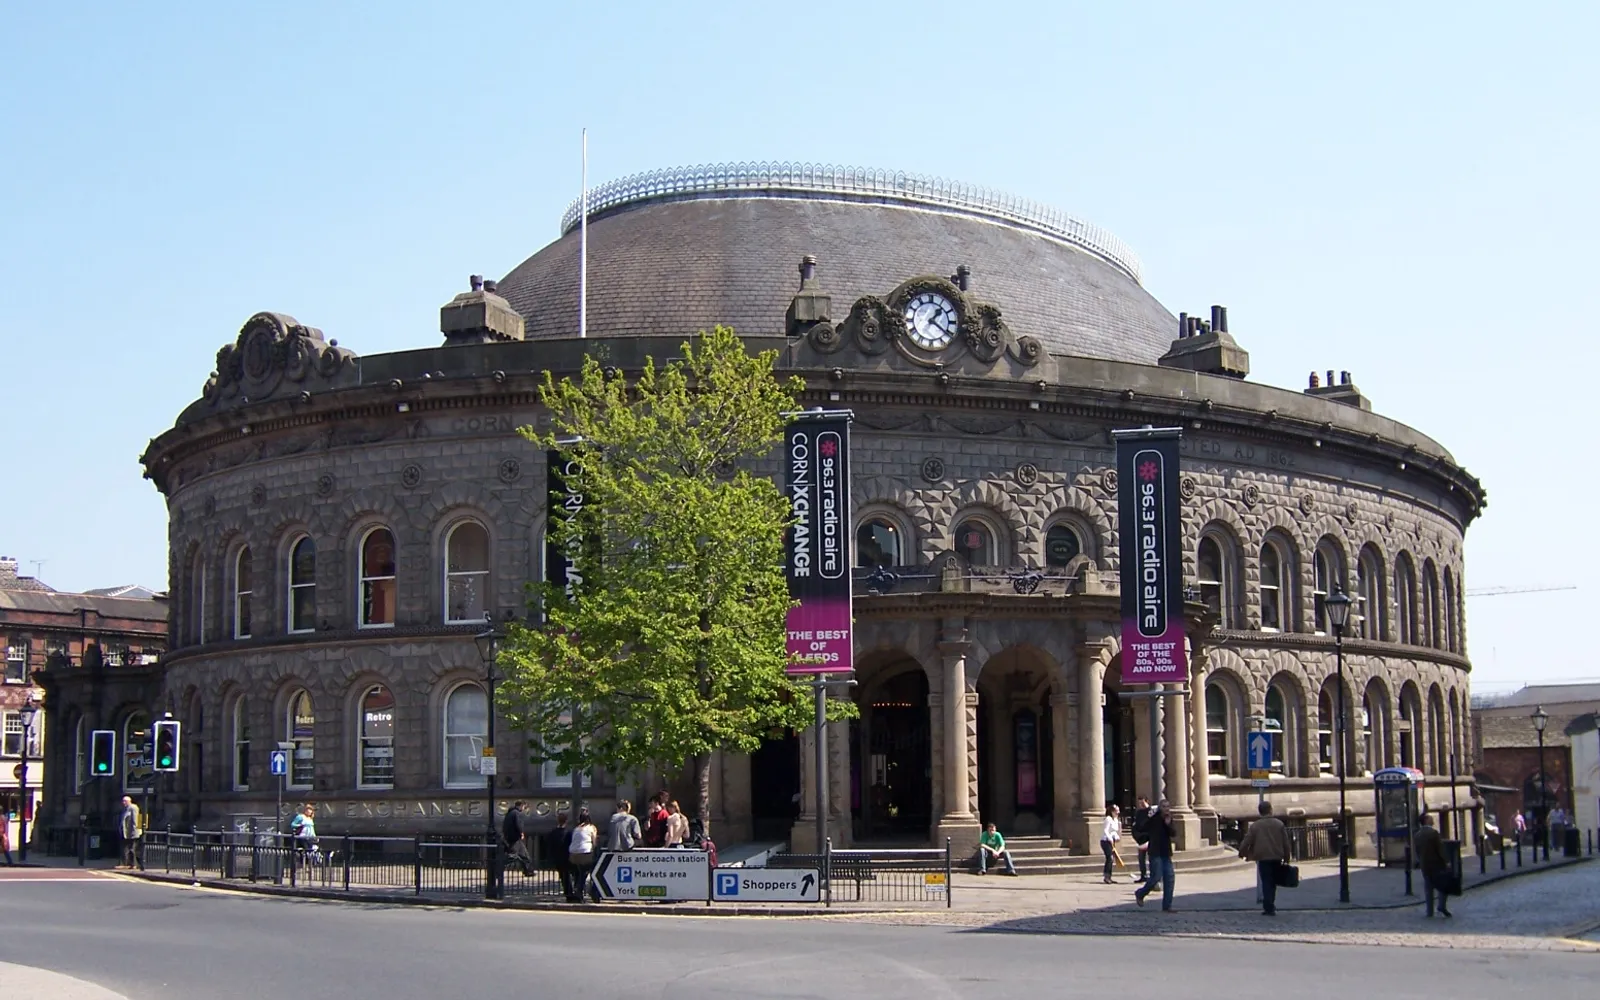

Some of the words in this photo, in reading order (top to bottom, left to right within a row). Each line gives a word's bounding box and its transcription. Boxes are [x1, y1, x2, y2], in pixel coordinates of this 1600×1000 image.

[451, 414, 513, 432] CORN
[822, 458, 835, 488] 96.3
[1141, 483, 1155, 522] 96.3
[823, 489, 838, 536] radio
[824, 537, 839, 571] aire
[1142, 524, 1160, 584] radio
[1144, 585, 1161, 628] aire
[788, 631, 813, 640] THE
[816, 630, 849, 640] BEST
[810, 641, 827, 651] OF
[1131, 643, 1150, 651] THE
[1152, 642, 1176, 650] BEST
[1136, 658, 1155, 666] 80s,
[1156, 657, 1173, 665] 90s
[366, 712, 392, 722] Retro
[281, 801, 336, 817] CON
[346, 800, 483, 817] EXCHANGE
[617, 855, 632, 863] Bus
[634, 855, 649, 863] and
[652, 855, 676, 863] coach
[678, 855, 706, 863] station
[620, 867, 630, 881] P
[634, 870, 667, 878] Markets
[617, 887, 635, 895] York
[721, 876, 736, 894] P
[742, 879, 797, 891] Shoppers
